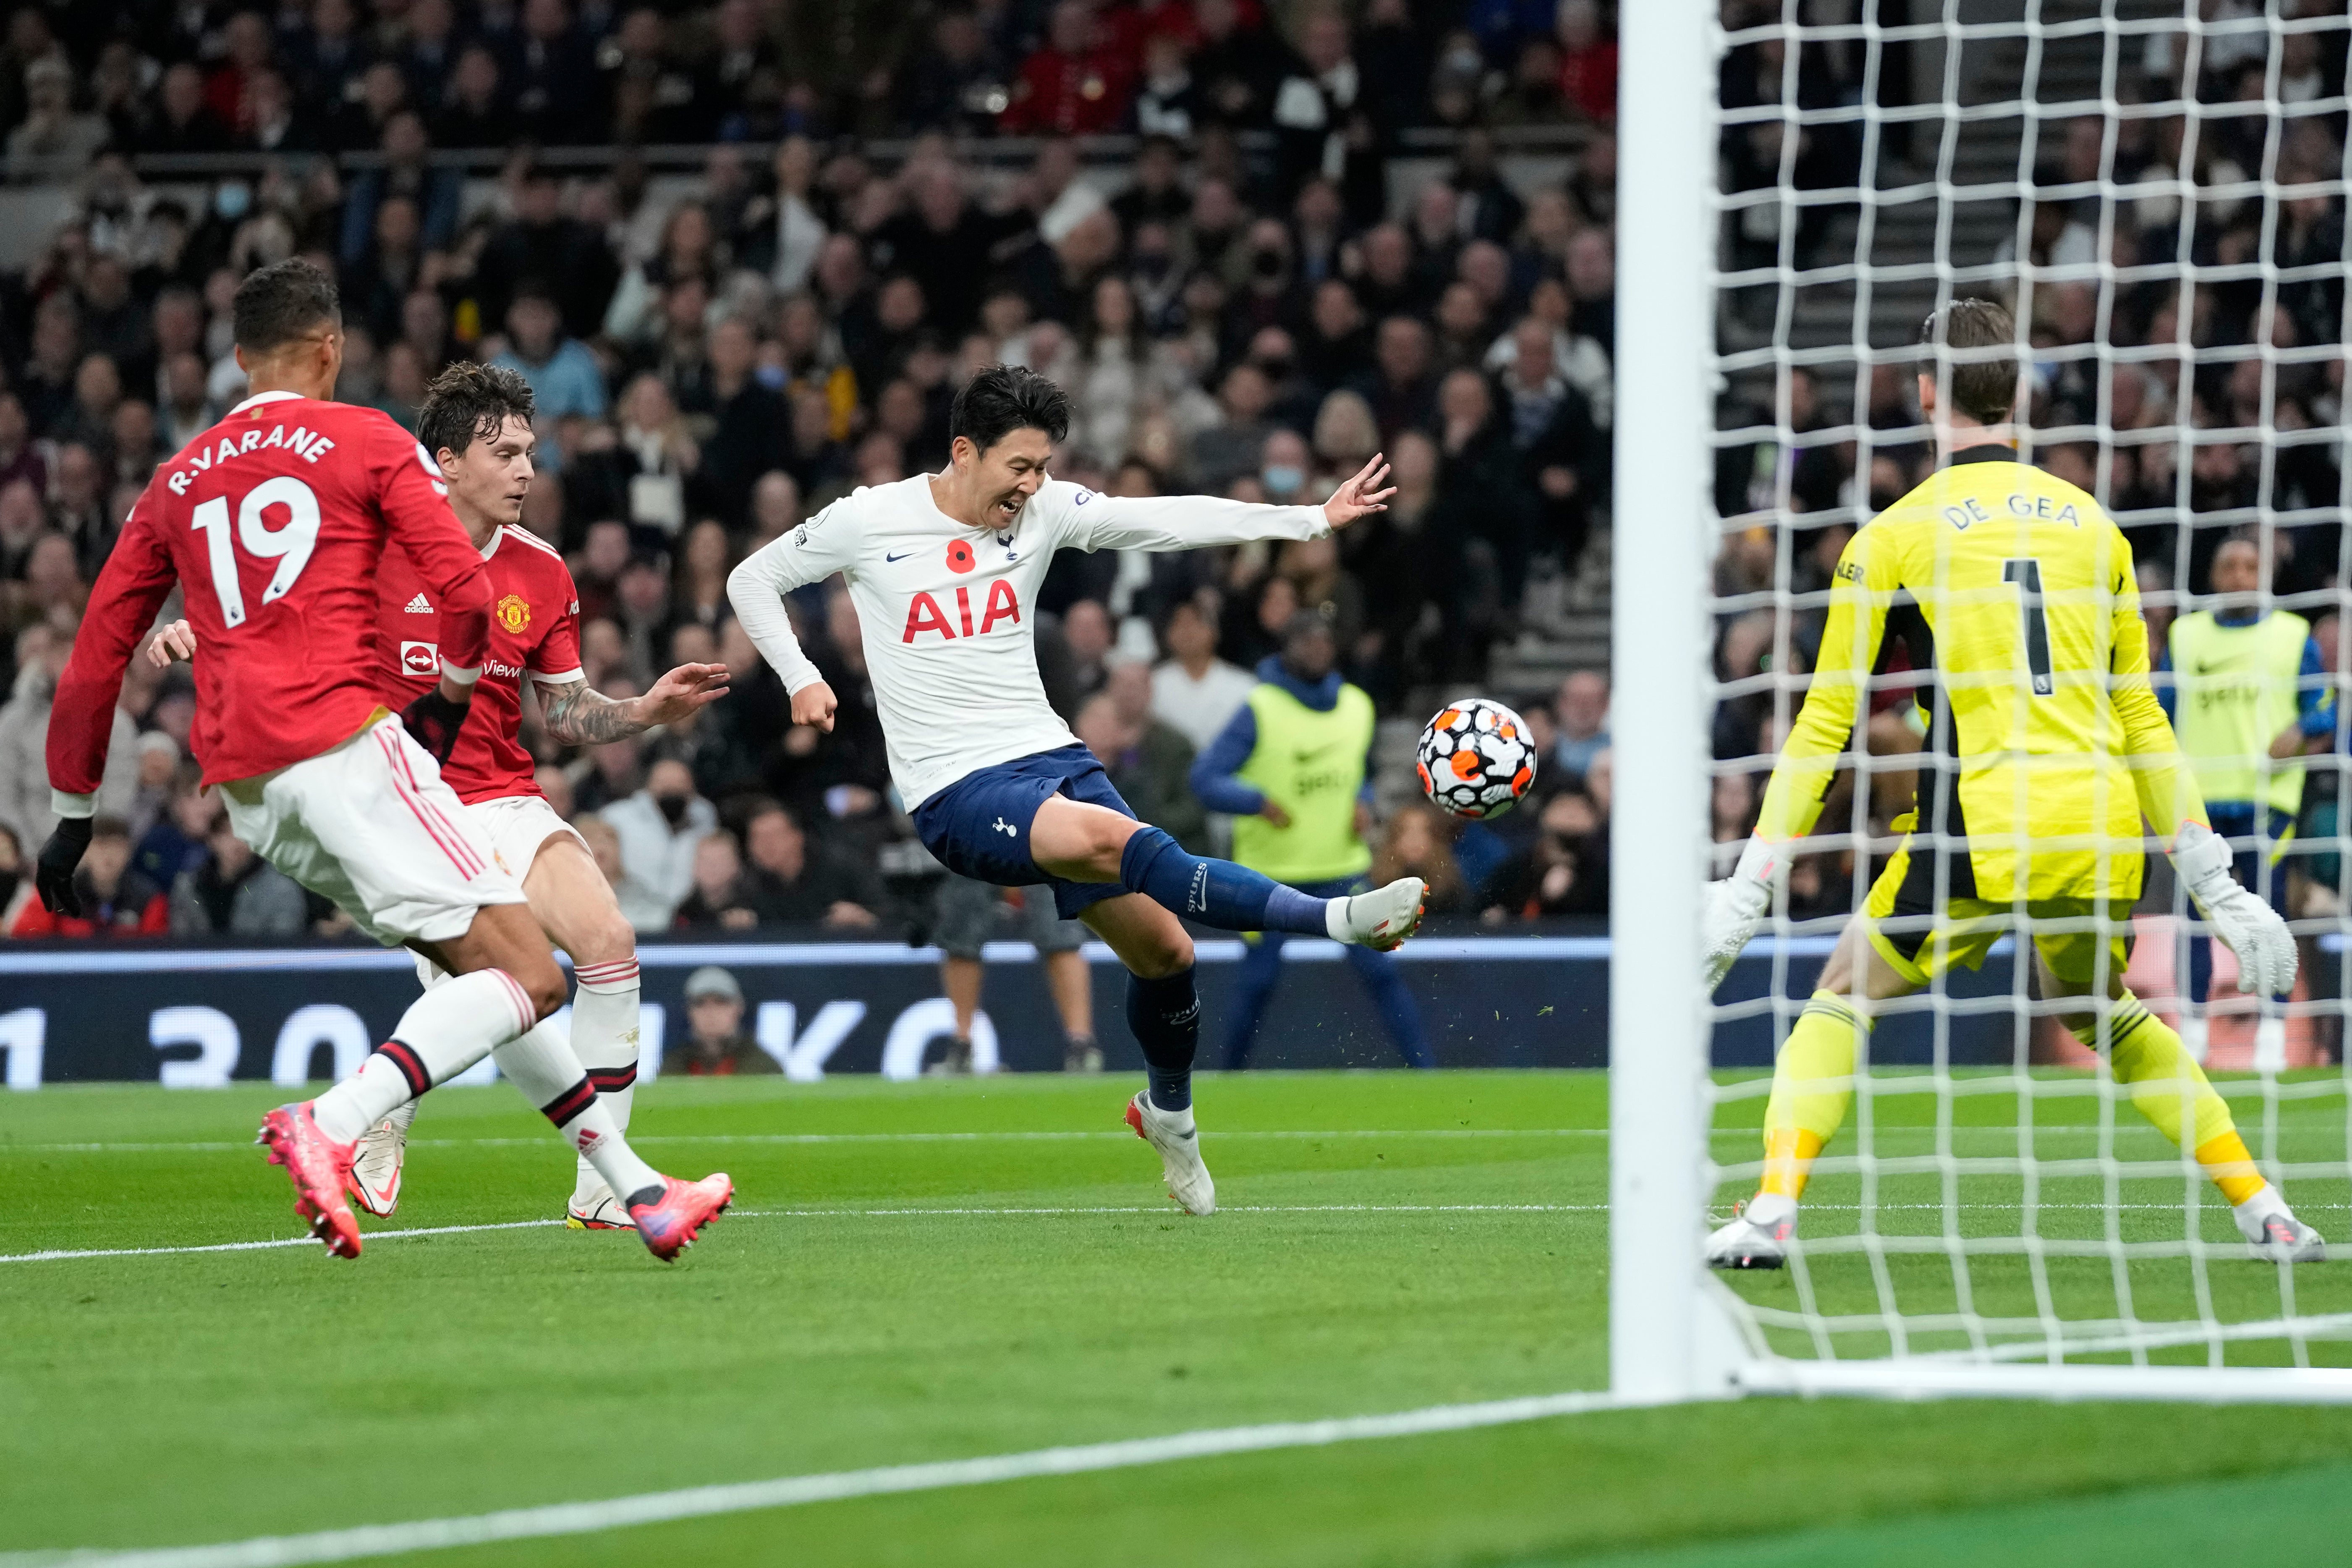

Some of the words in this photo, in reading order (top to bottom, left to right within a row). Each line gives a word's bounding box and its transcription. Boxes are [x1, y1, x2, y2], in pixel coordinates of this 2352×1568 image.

[168, 424, 335, 496] R.VARANE
[1945, 498, 1989, 530] DE
[2008, 494, 2080, 527] GEA
[191, 476, 322, 629] 19
[404, 604, 434, 613] adidas
[902, 579, 1021, 644] AIA
[2003, 559, 2054, 695] 1
[1188, 862, 1207, 913] SPURS
